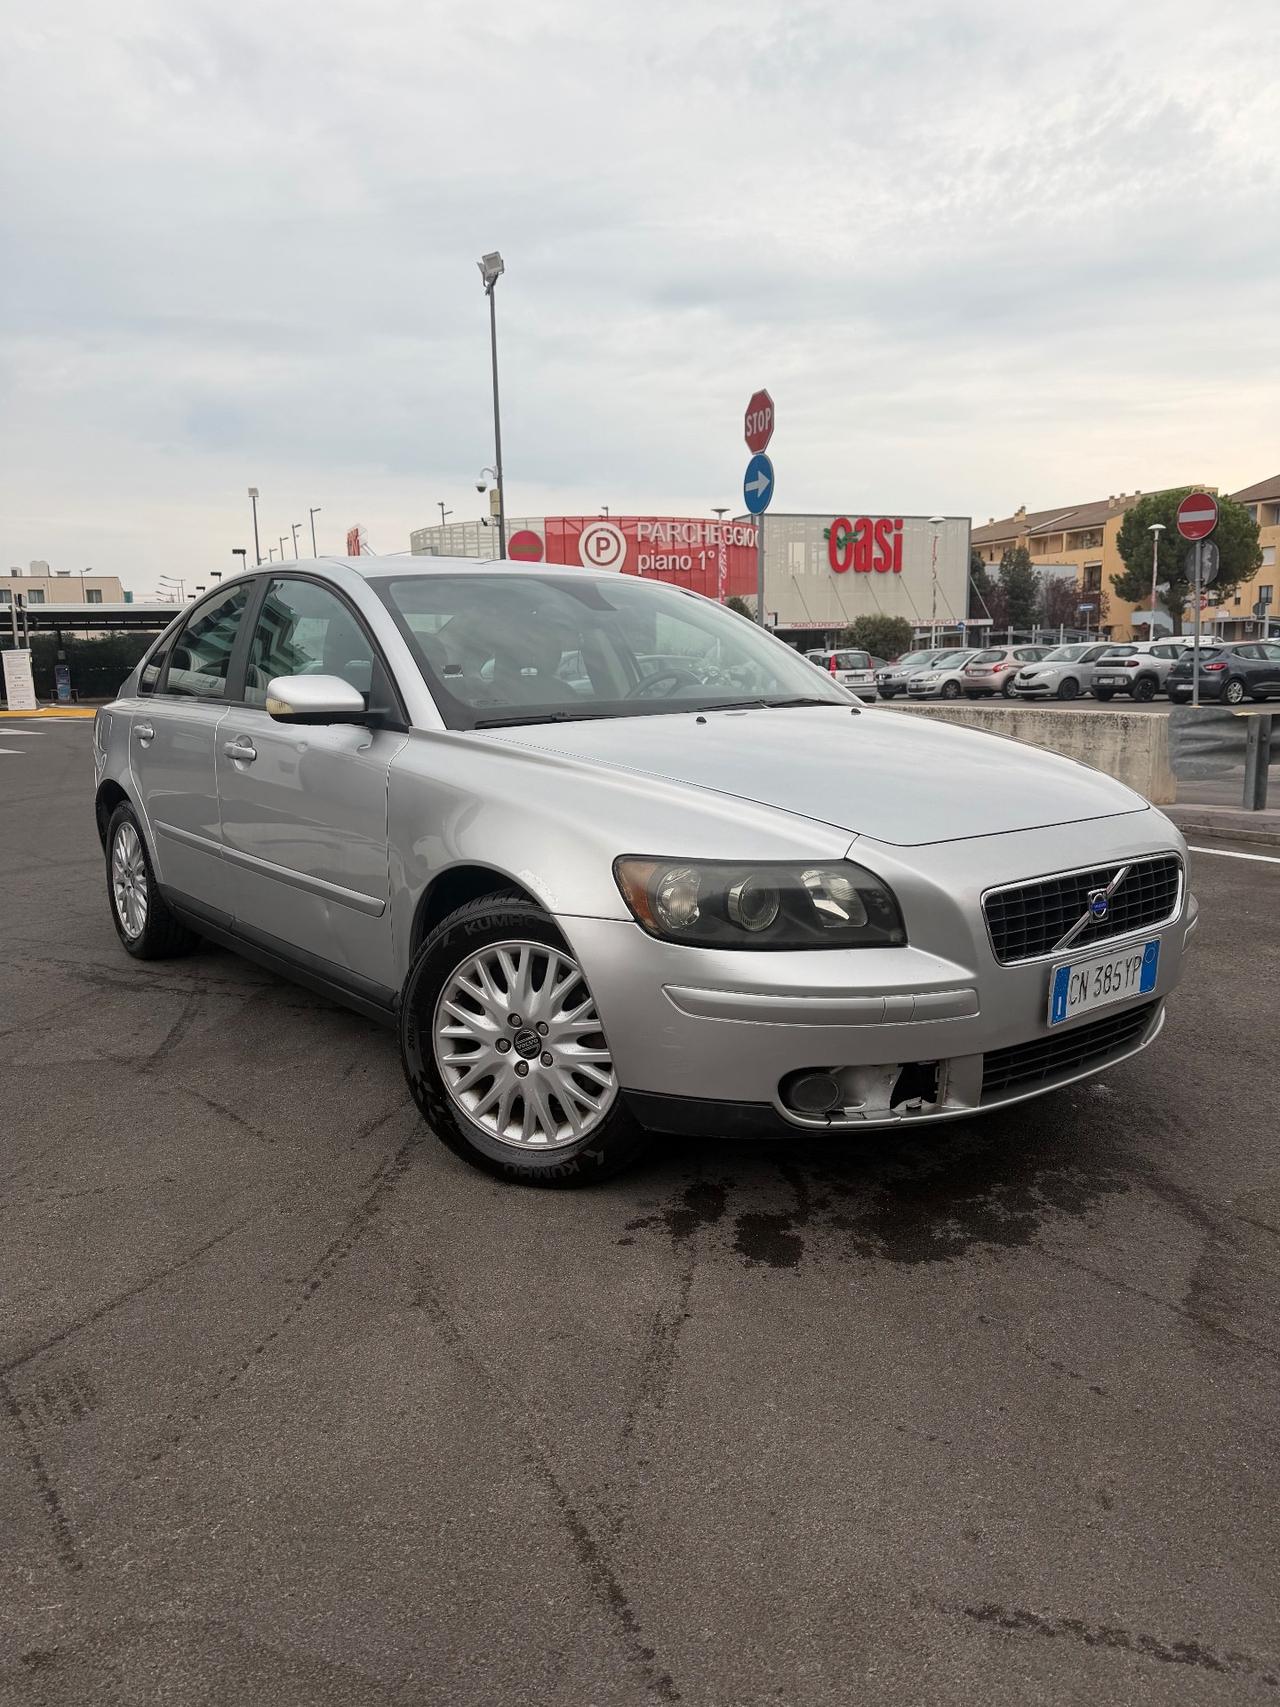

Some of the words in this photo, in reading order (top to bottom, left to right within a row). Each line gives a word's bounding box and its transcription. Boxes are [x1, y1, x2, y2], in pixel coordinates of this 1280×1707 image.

[746, 407, 771, 437] STOP
[596, 537, 611, 557] P
[637, 522, 754, 548] PARCHEGGIO
[638, 550, 692, 574] piano
[1069, 969, 1089, 1005] CN
[1057, 996, 1062, 1015] I
